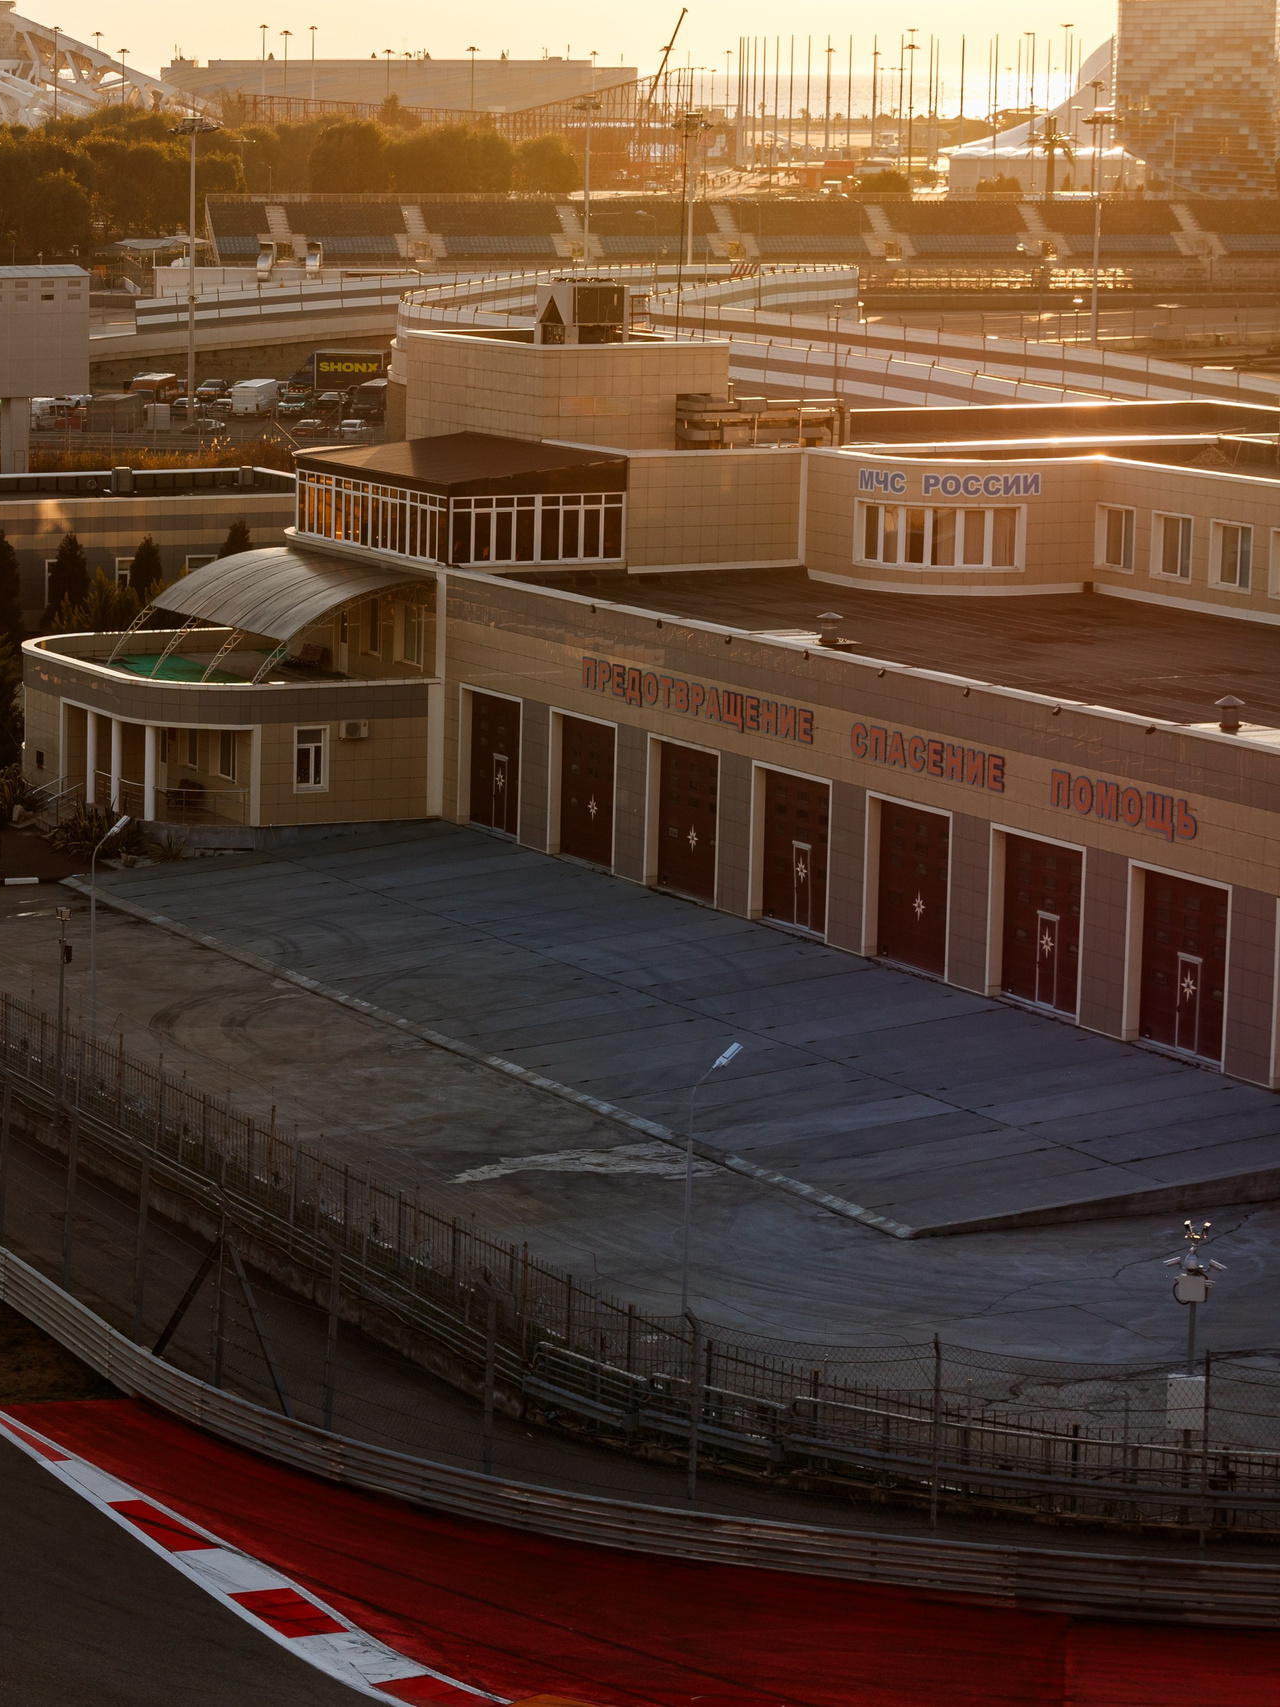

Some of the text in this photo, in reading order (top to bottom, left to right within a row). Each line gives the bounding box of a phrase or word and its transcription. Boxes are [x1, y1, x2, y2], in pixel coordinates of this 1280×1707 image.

[319, 361, 379, 373] SHONX
[859, 468, 1041, 497] МЧС РОССИИ
[582, 656, 1197, 842] ПРЕДОТВРАЩЕНИЕ СПАСЕНИЕ ПОМОЩЬ
